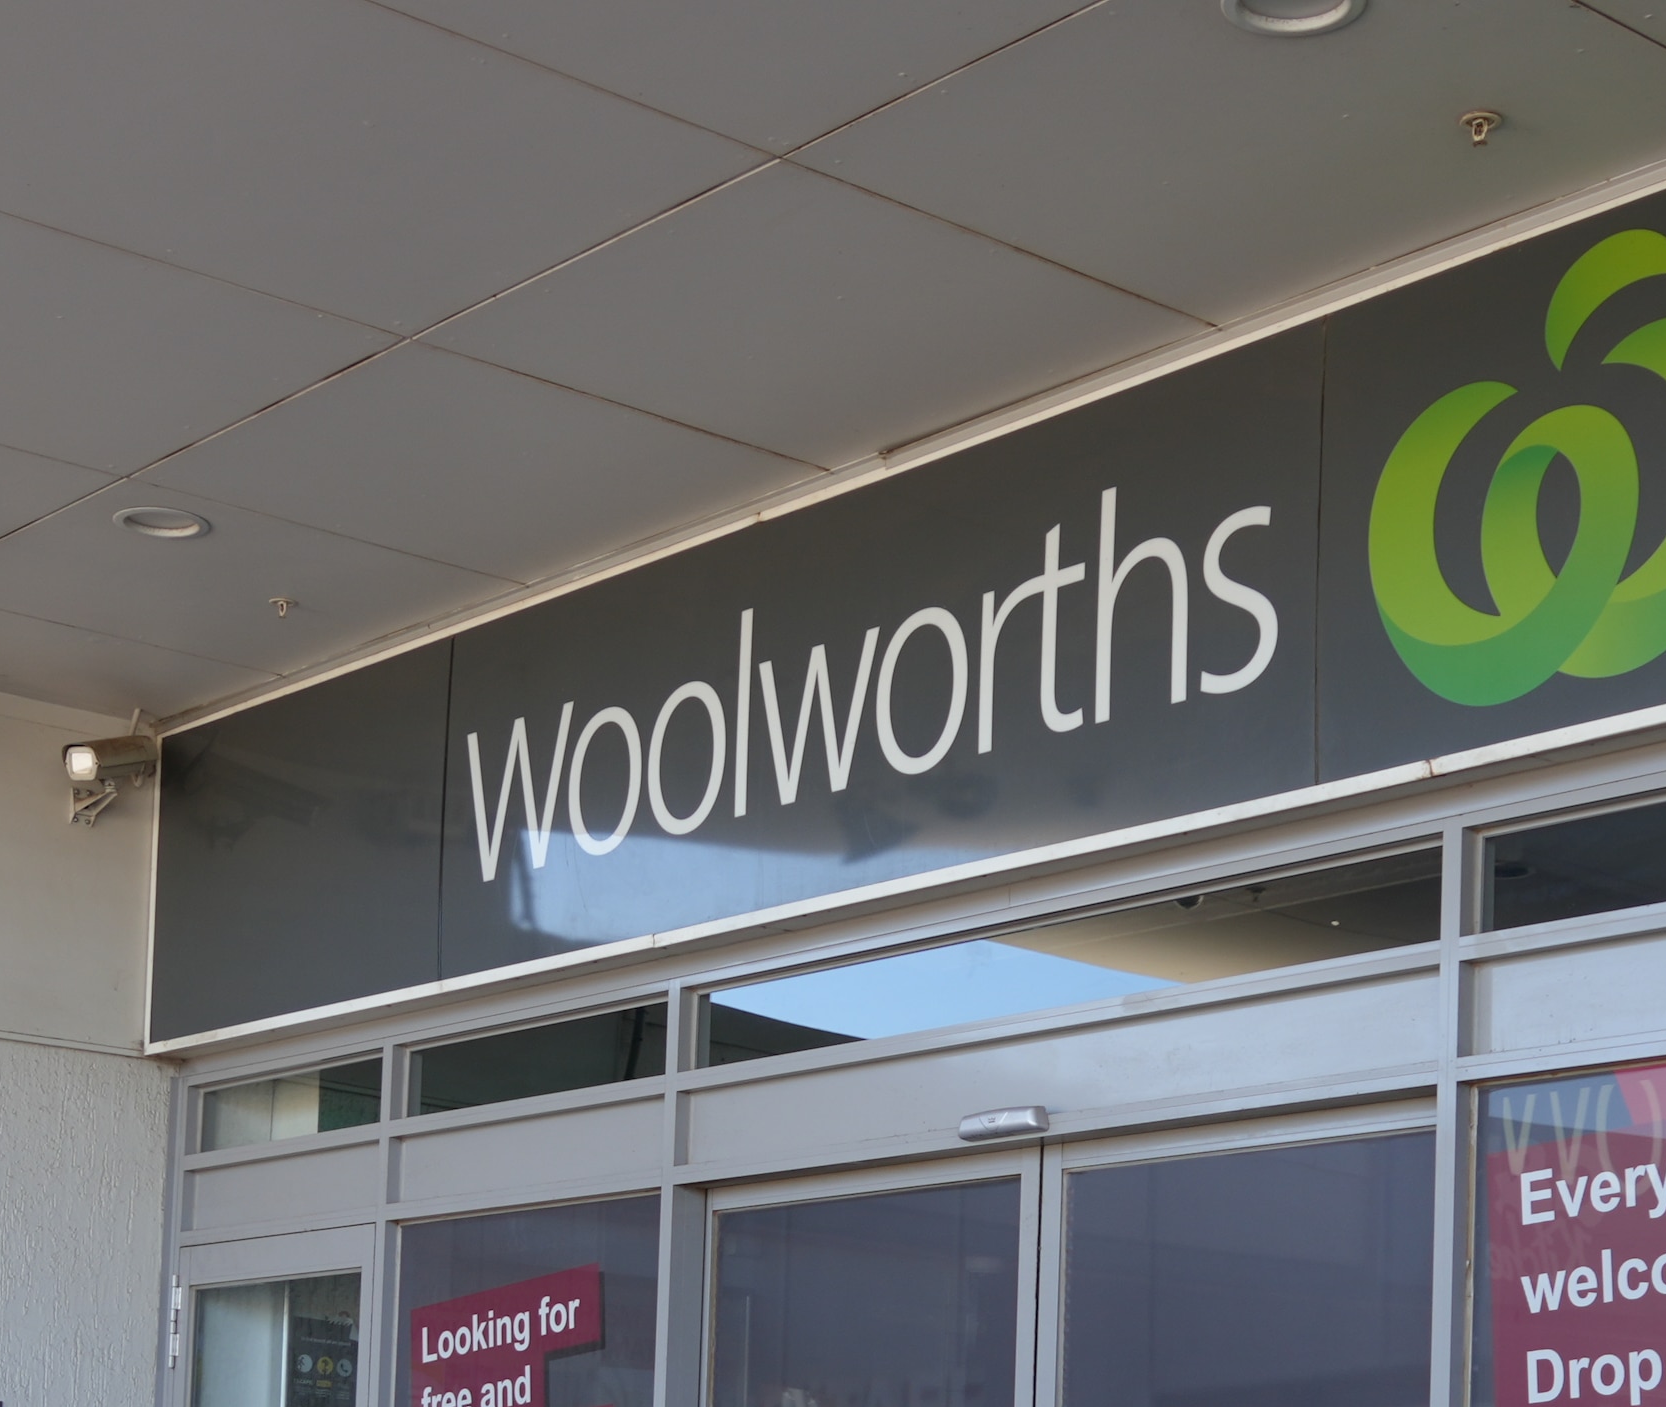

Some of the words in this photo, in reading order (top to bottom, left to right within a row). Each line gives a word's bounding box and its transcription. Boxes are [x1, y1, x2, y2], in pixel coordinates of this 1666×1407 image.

[467, 487, 1278, 882] Woolworths
[421, 1310, 530, 1363] Looking
[539, 1296, 580, 1336] for
[1526, 1345, 1663, 1407] Drop
